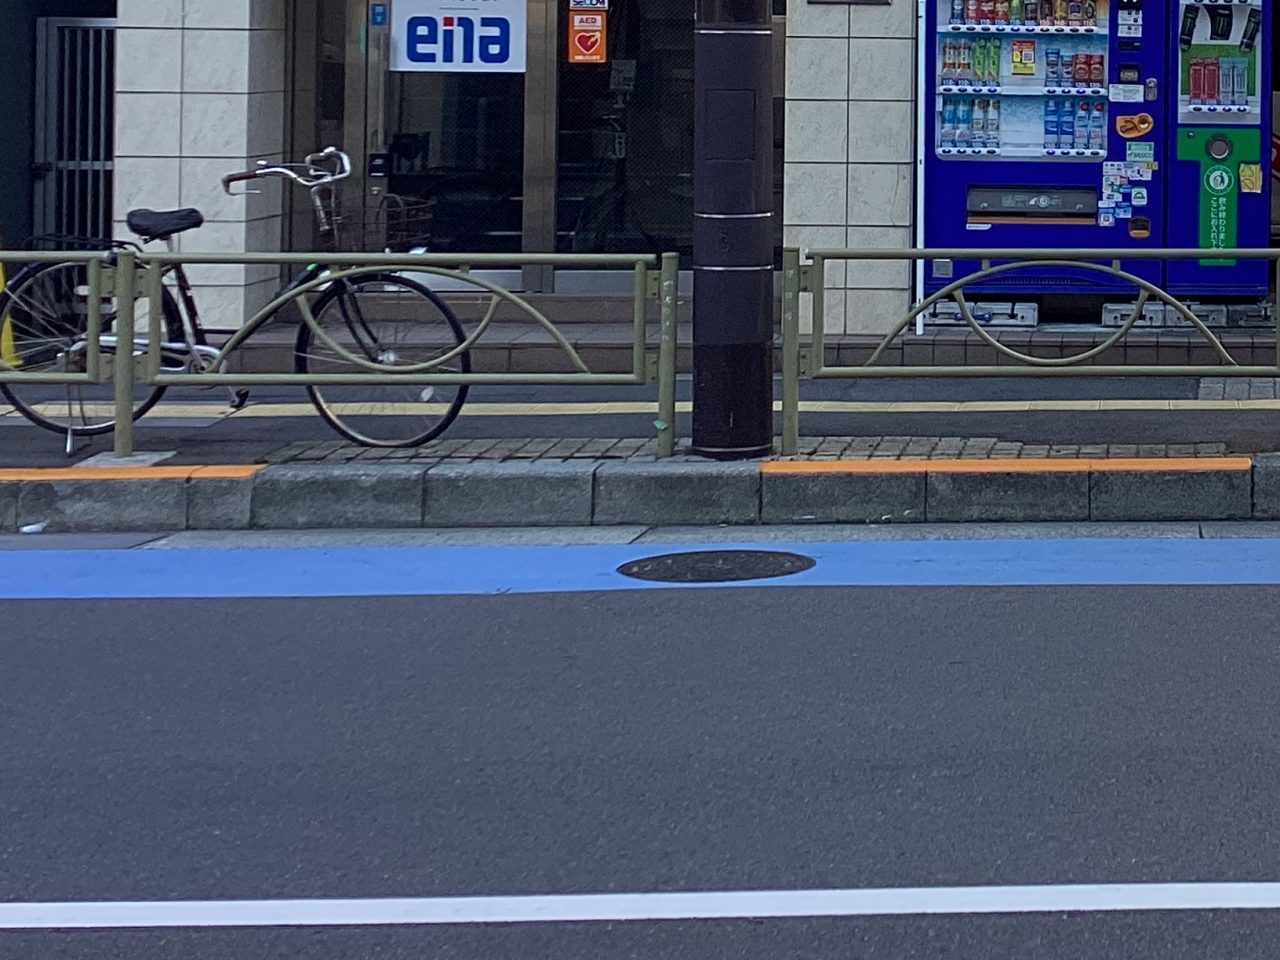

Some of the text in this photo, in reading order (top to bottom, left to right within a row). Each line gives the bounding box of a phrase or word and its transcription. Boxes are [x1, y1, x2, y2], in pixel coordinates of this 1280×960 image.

[407, 16, 510, 64] ena
[1210, 197, 1218, 248] ここにお入れ下
[1218, 197, 1227, 248] 飲み終わりまし
